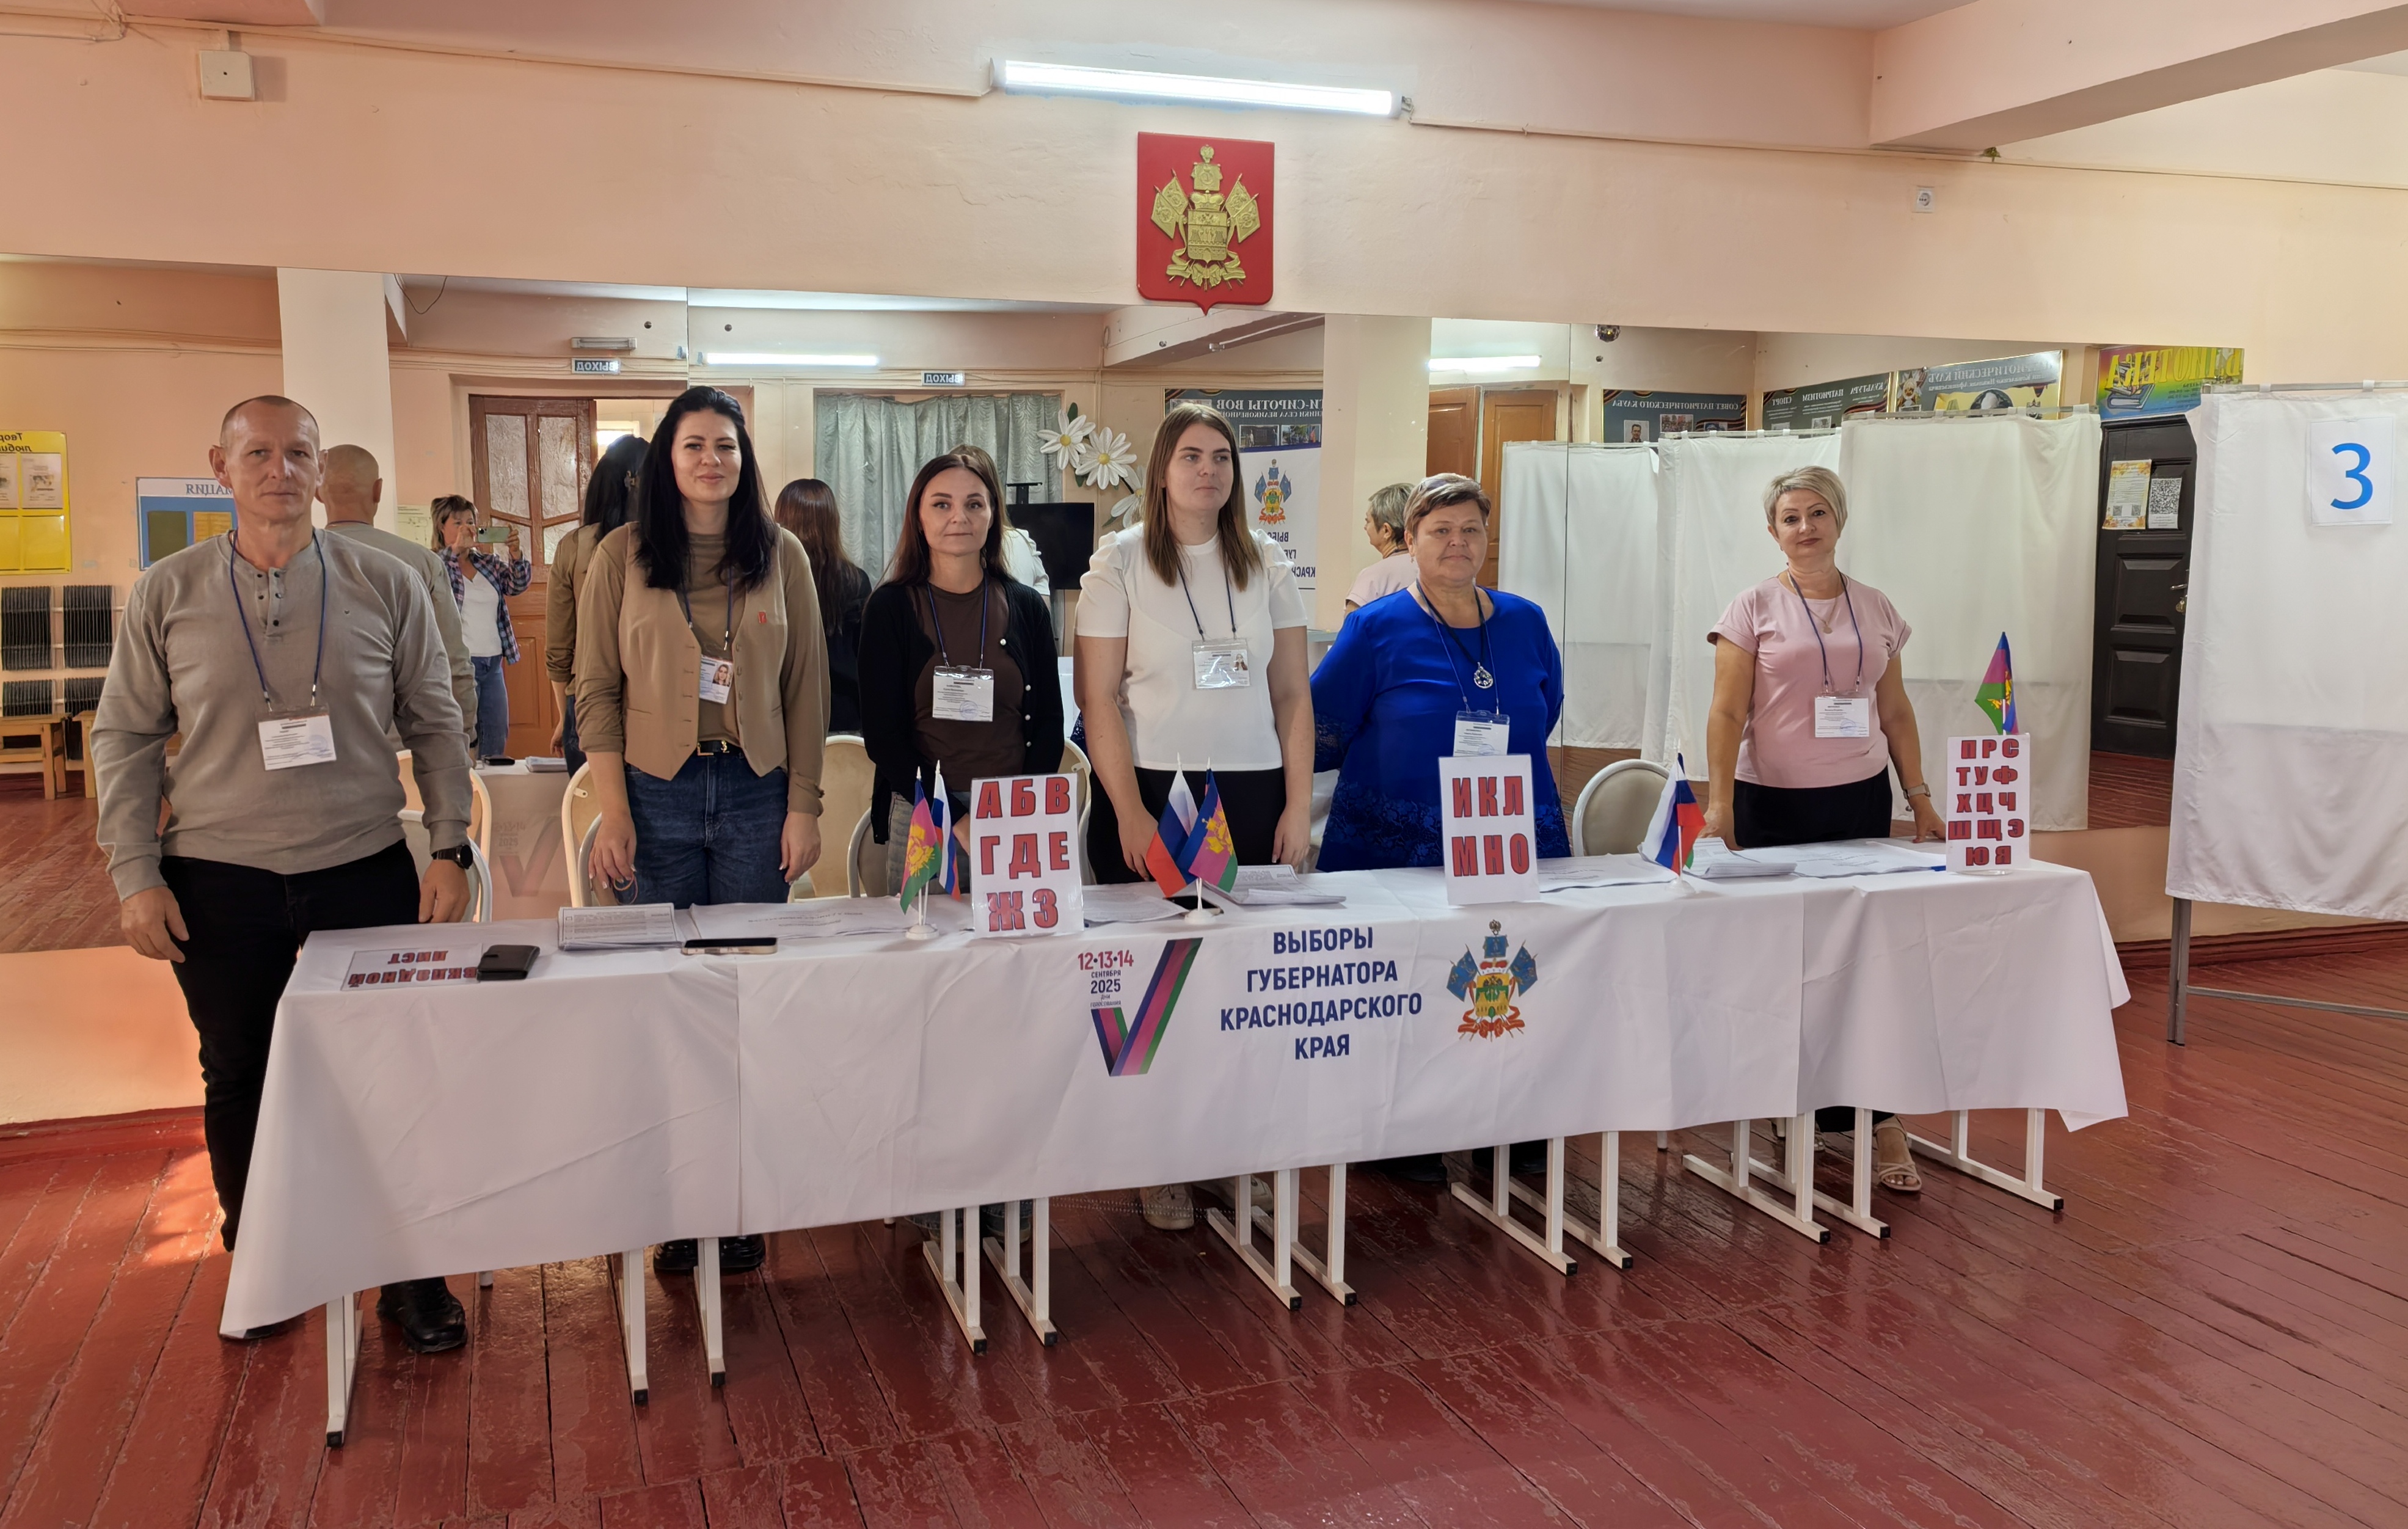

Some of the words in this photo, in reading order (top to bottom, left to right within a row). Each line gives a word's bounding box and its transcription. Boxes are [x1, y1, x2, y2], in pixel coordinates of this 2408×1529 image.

[2330, 443, 2373, 509] 3
[1273, 927, 1373, 954] ВЫБОРЫ
[1090, 979, 1121, 994] 2025
[1091, 969, 1122, 979] СЕНТЯБРЯ
[1247, 960, 1398, 992] ГУБЕРНАТОРА
[1221, 993, 1422, 1031] КРАСНОДАРСКОГО
[1295, 1034, 1349, 1060] КРАЯ
